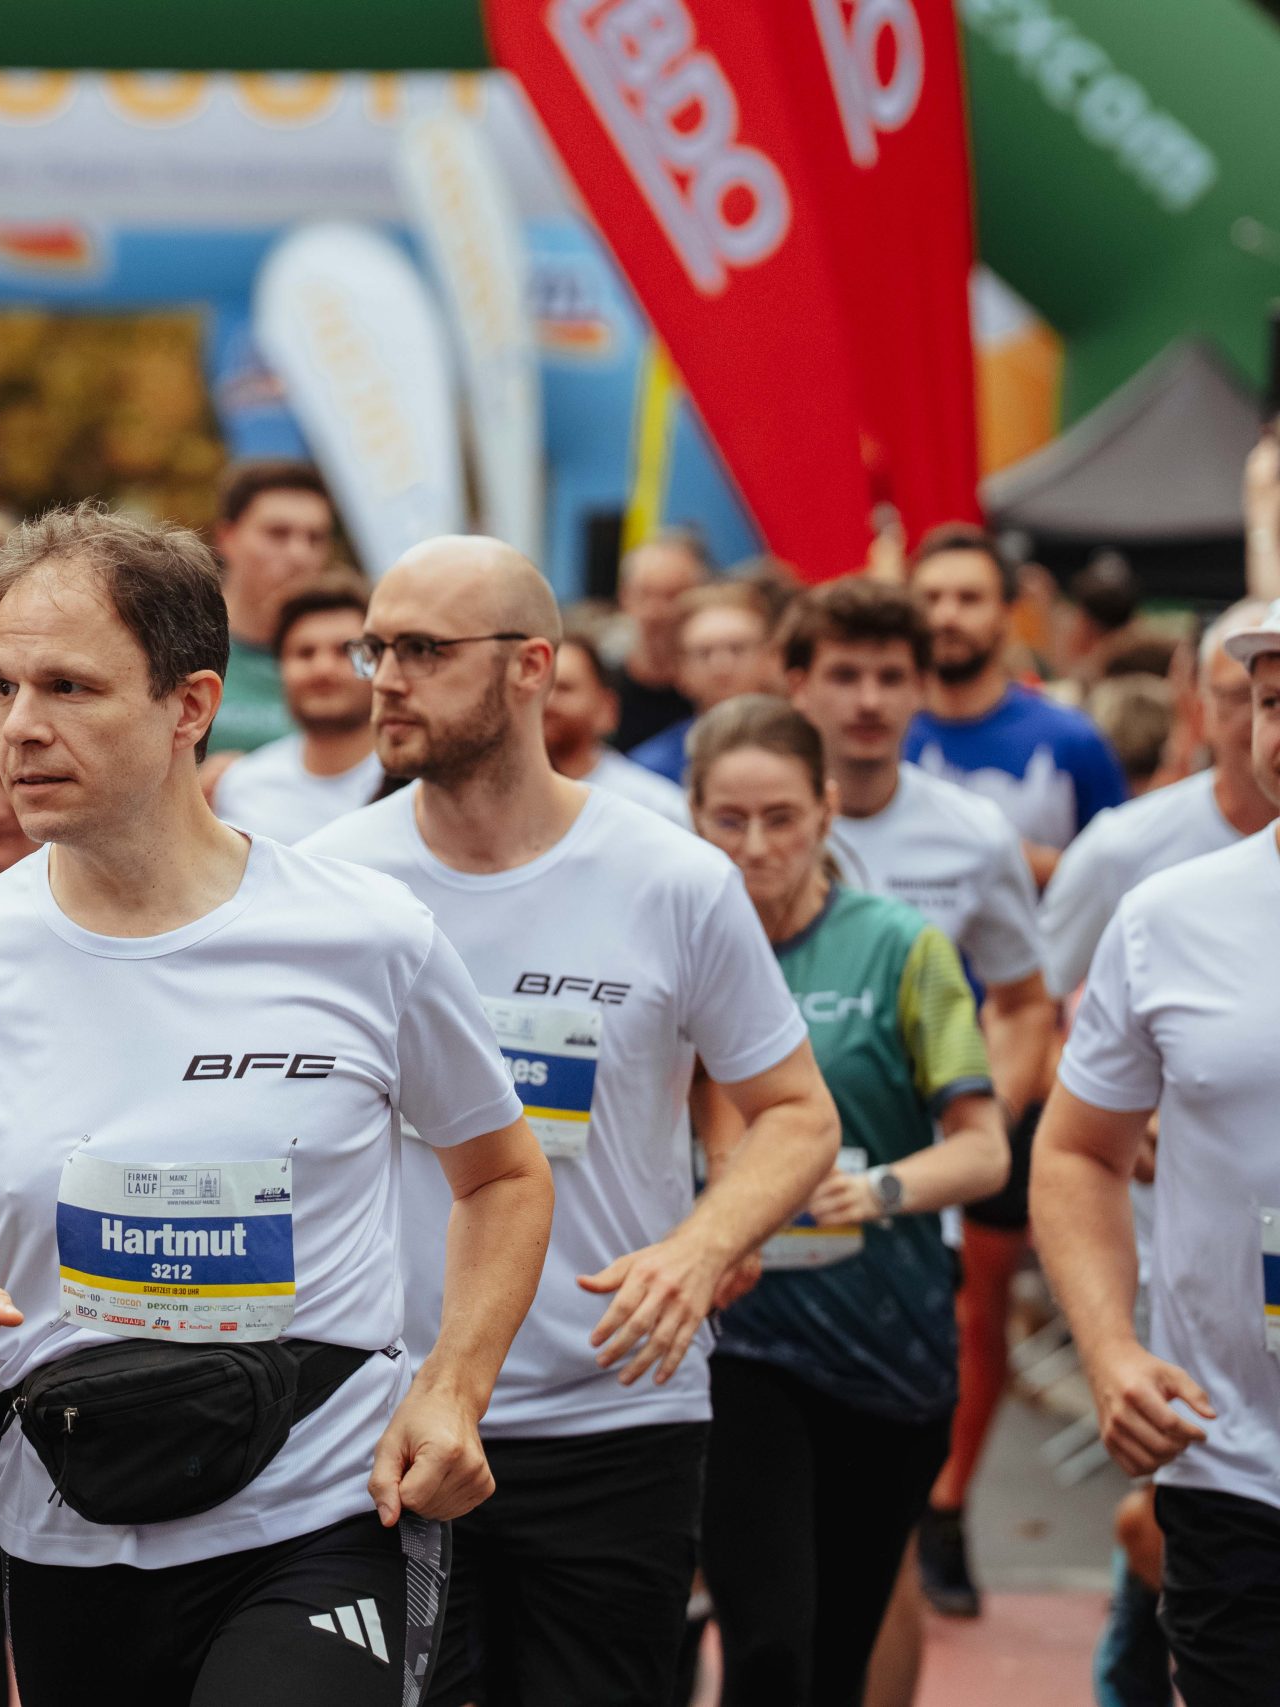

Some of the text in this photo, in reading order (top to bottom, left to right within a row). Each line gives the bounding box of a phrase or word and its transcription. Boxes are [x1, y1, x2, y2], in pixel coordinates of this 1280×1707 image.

[565, 0, 792, 280] BDO
[513, 971, 631, 1005] BFE
[182, 1053, 337, 1082] BFE
[508, 1056, 549, 1087] es
[128, 1172, 158, 1182] FIRMEN
[169, 1174, 188, 1182] MAINZ
[127, 1182, 157, 1195] LAUF
[101, 1217, 247, 1257] Hartmut
[151, 1262, 193, 1280] 3212
[143, 1285, 171, 1295] STARTZEIT
[78, 1306, 98, 1318] BDO
[155, 1317, 170, 1327] dm
